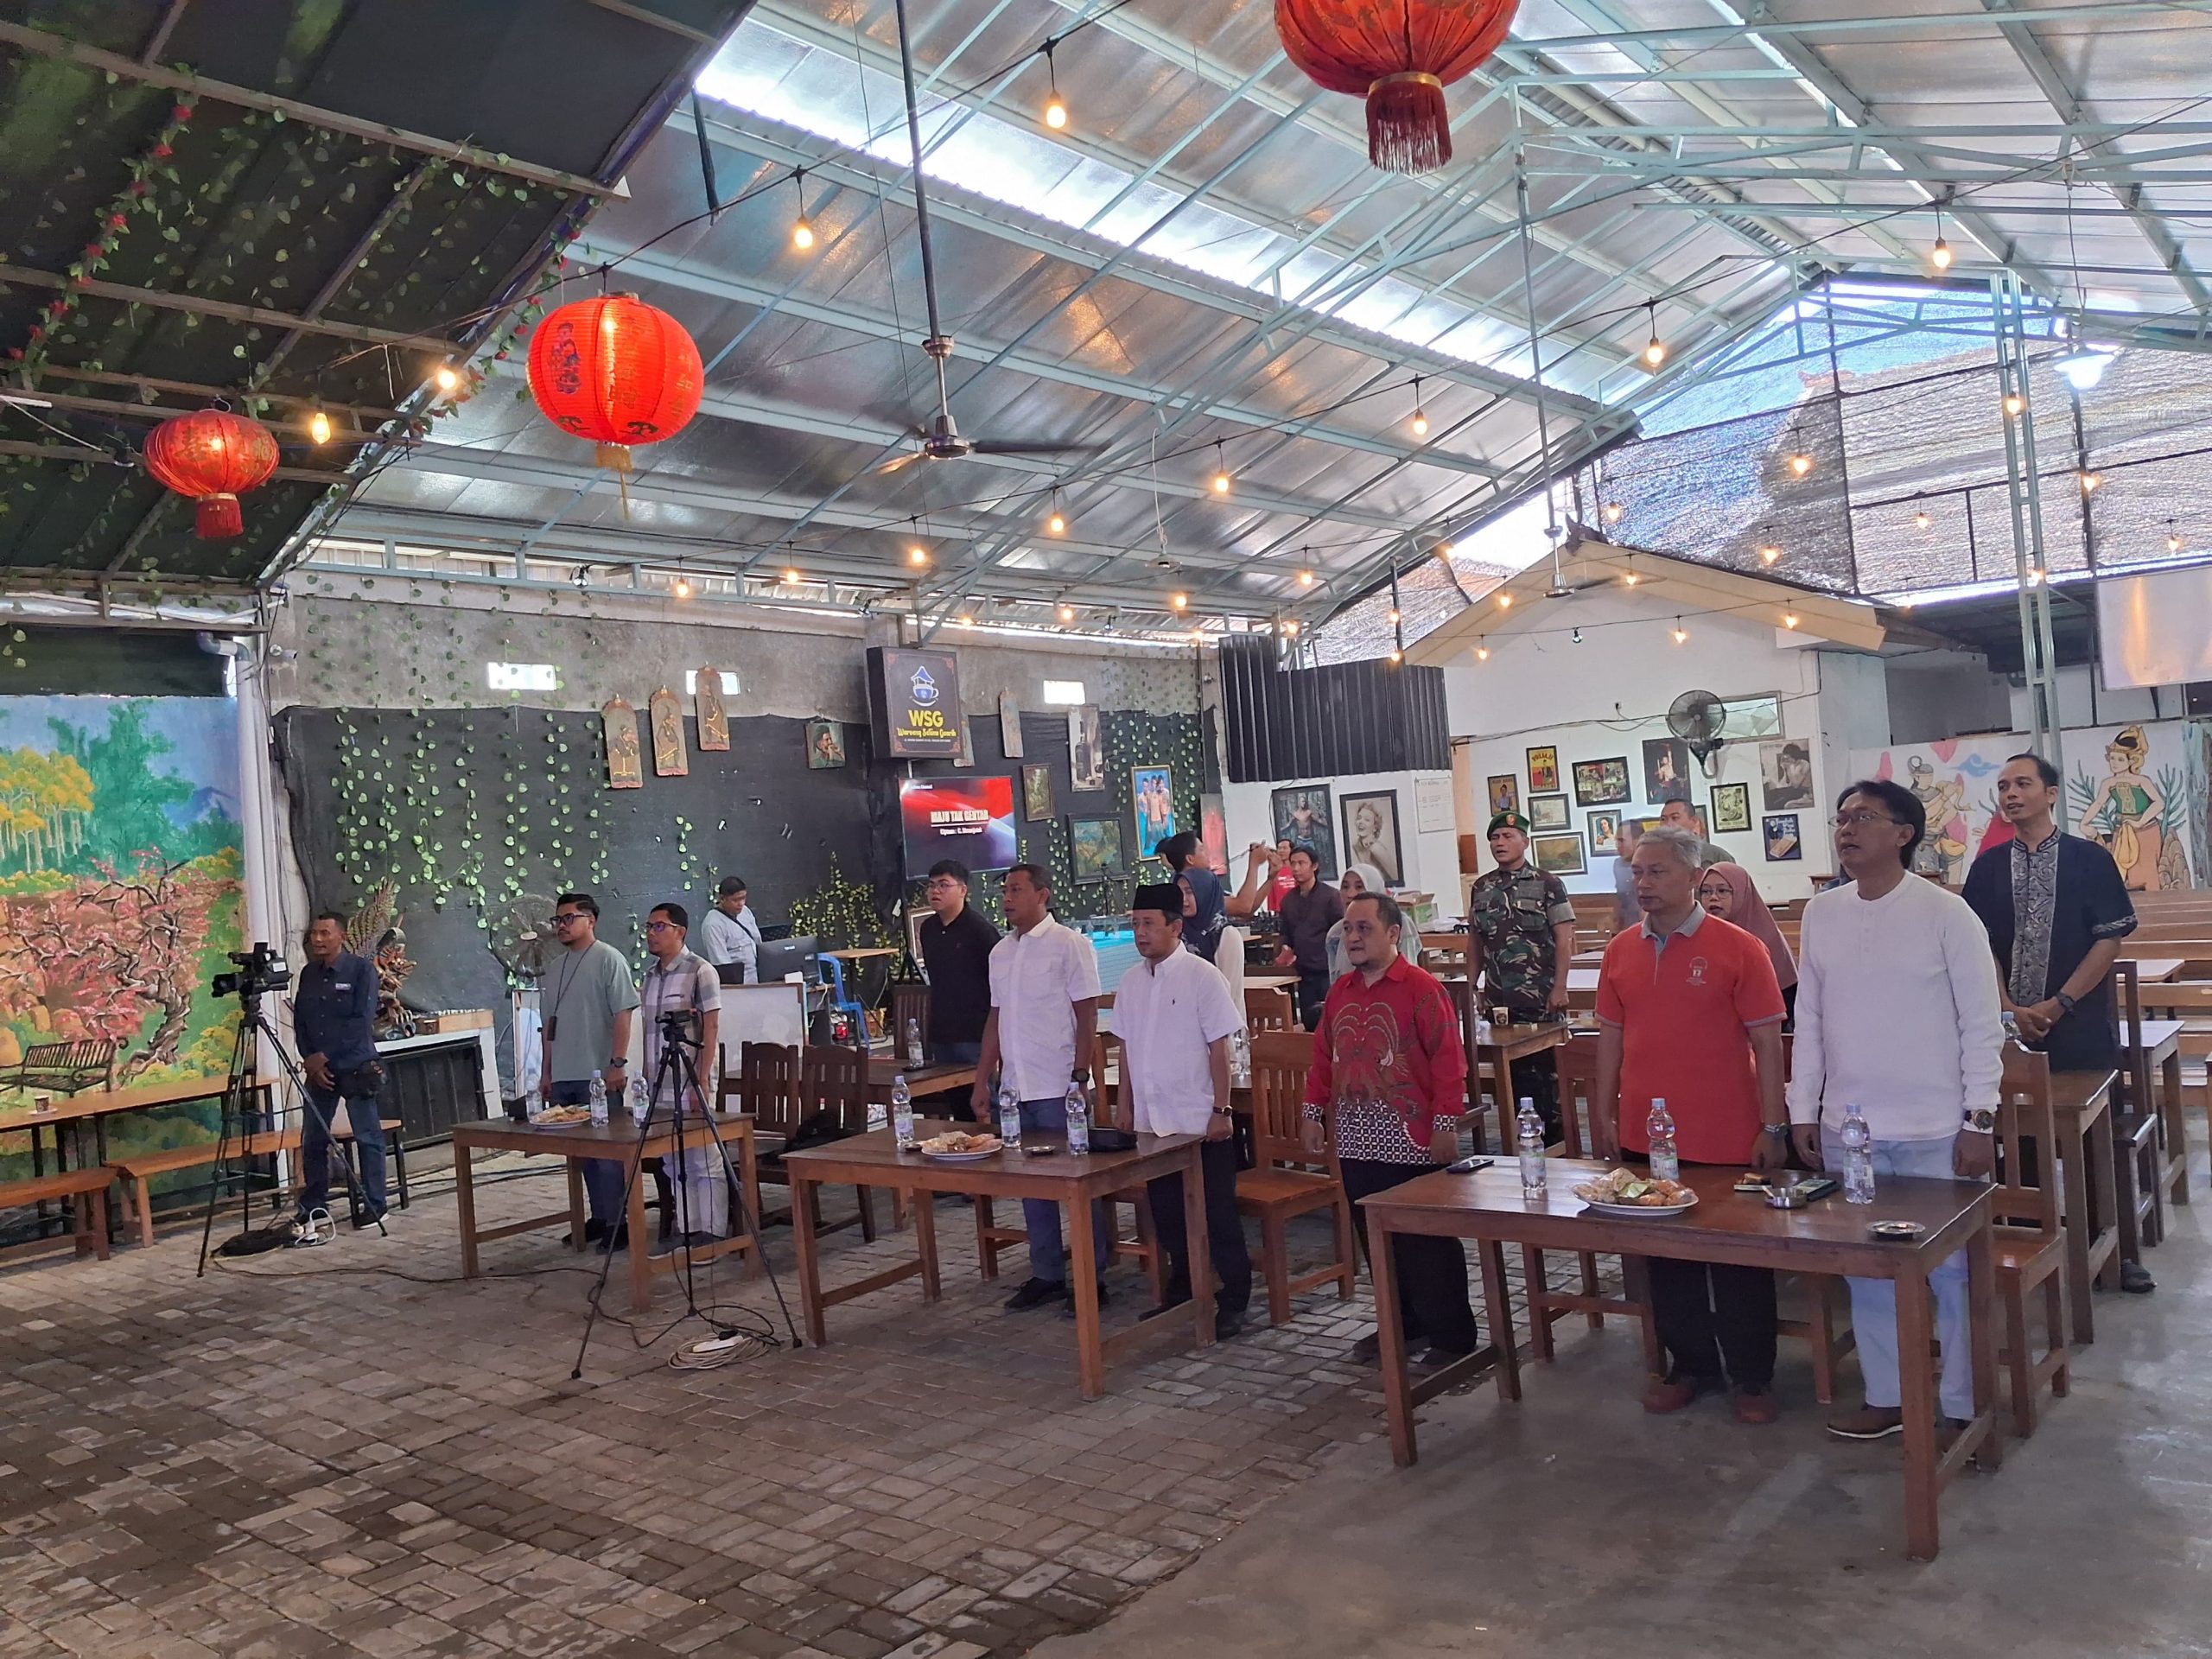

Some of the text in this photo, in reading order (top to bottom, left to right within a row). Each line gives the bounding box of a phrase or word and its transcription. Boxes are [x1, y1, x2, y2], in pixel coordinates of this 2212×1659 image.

[908, 709, 944, 728] WSG
[931, 809, 988, 823] MAJU TAK GENTAR
